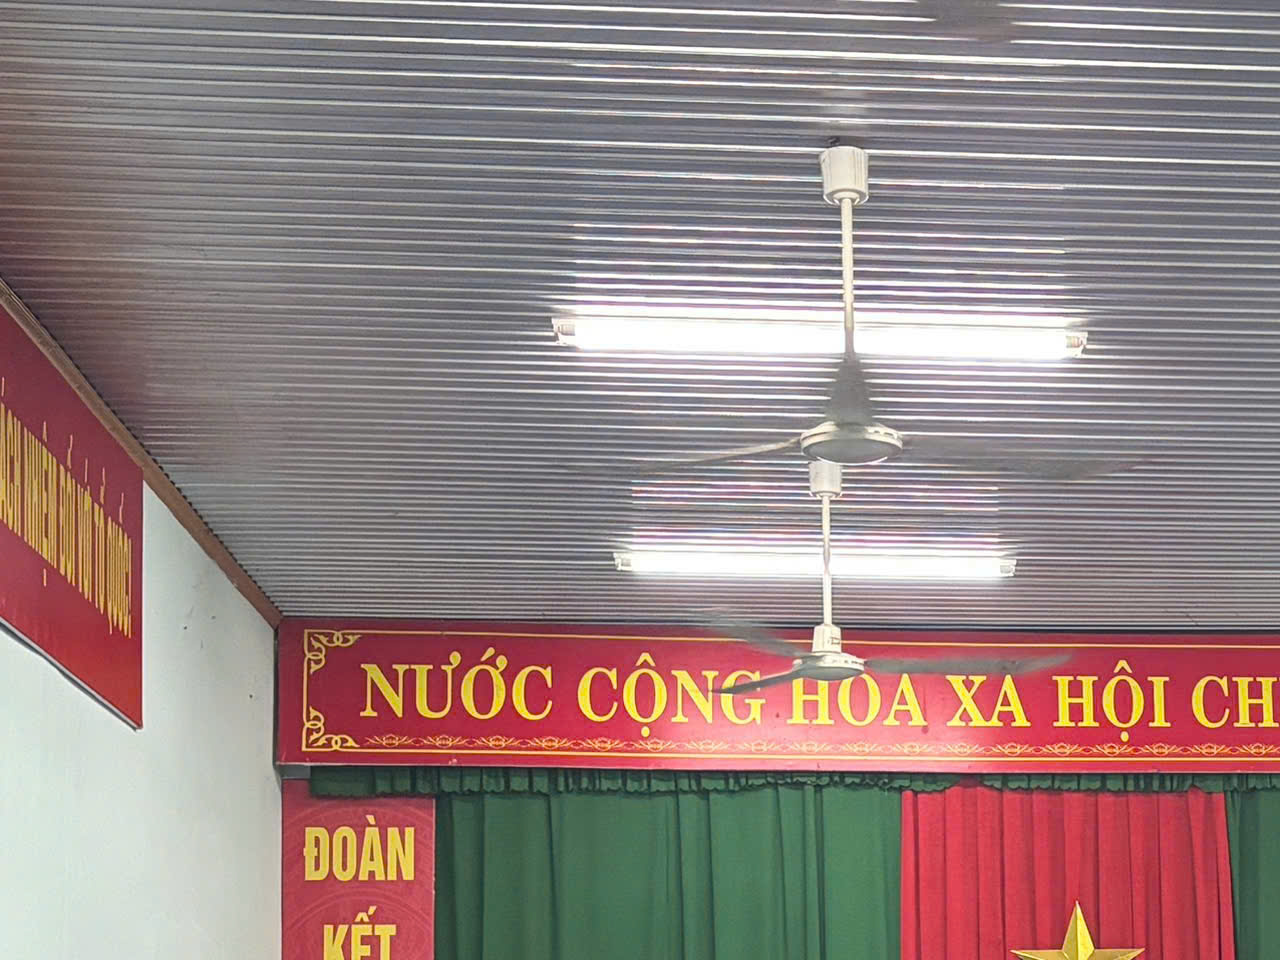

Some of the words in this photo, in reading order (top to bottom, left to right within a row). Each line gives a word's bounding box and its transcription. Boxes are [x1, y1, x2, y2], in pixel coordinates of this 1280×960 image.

[359, 646, 553, 720] NƯỚC
[576, 651, 767, 738] CỘNG
[1051, 659, 1172, 743] HỘI
[303, 814, 415, 881] ĐOÀN
